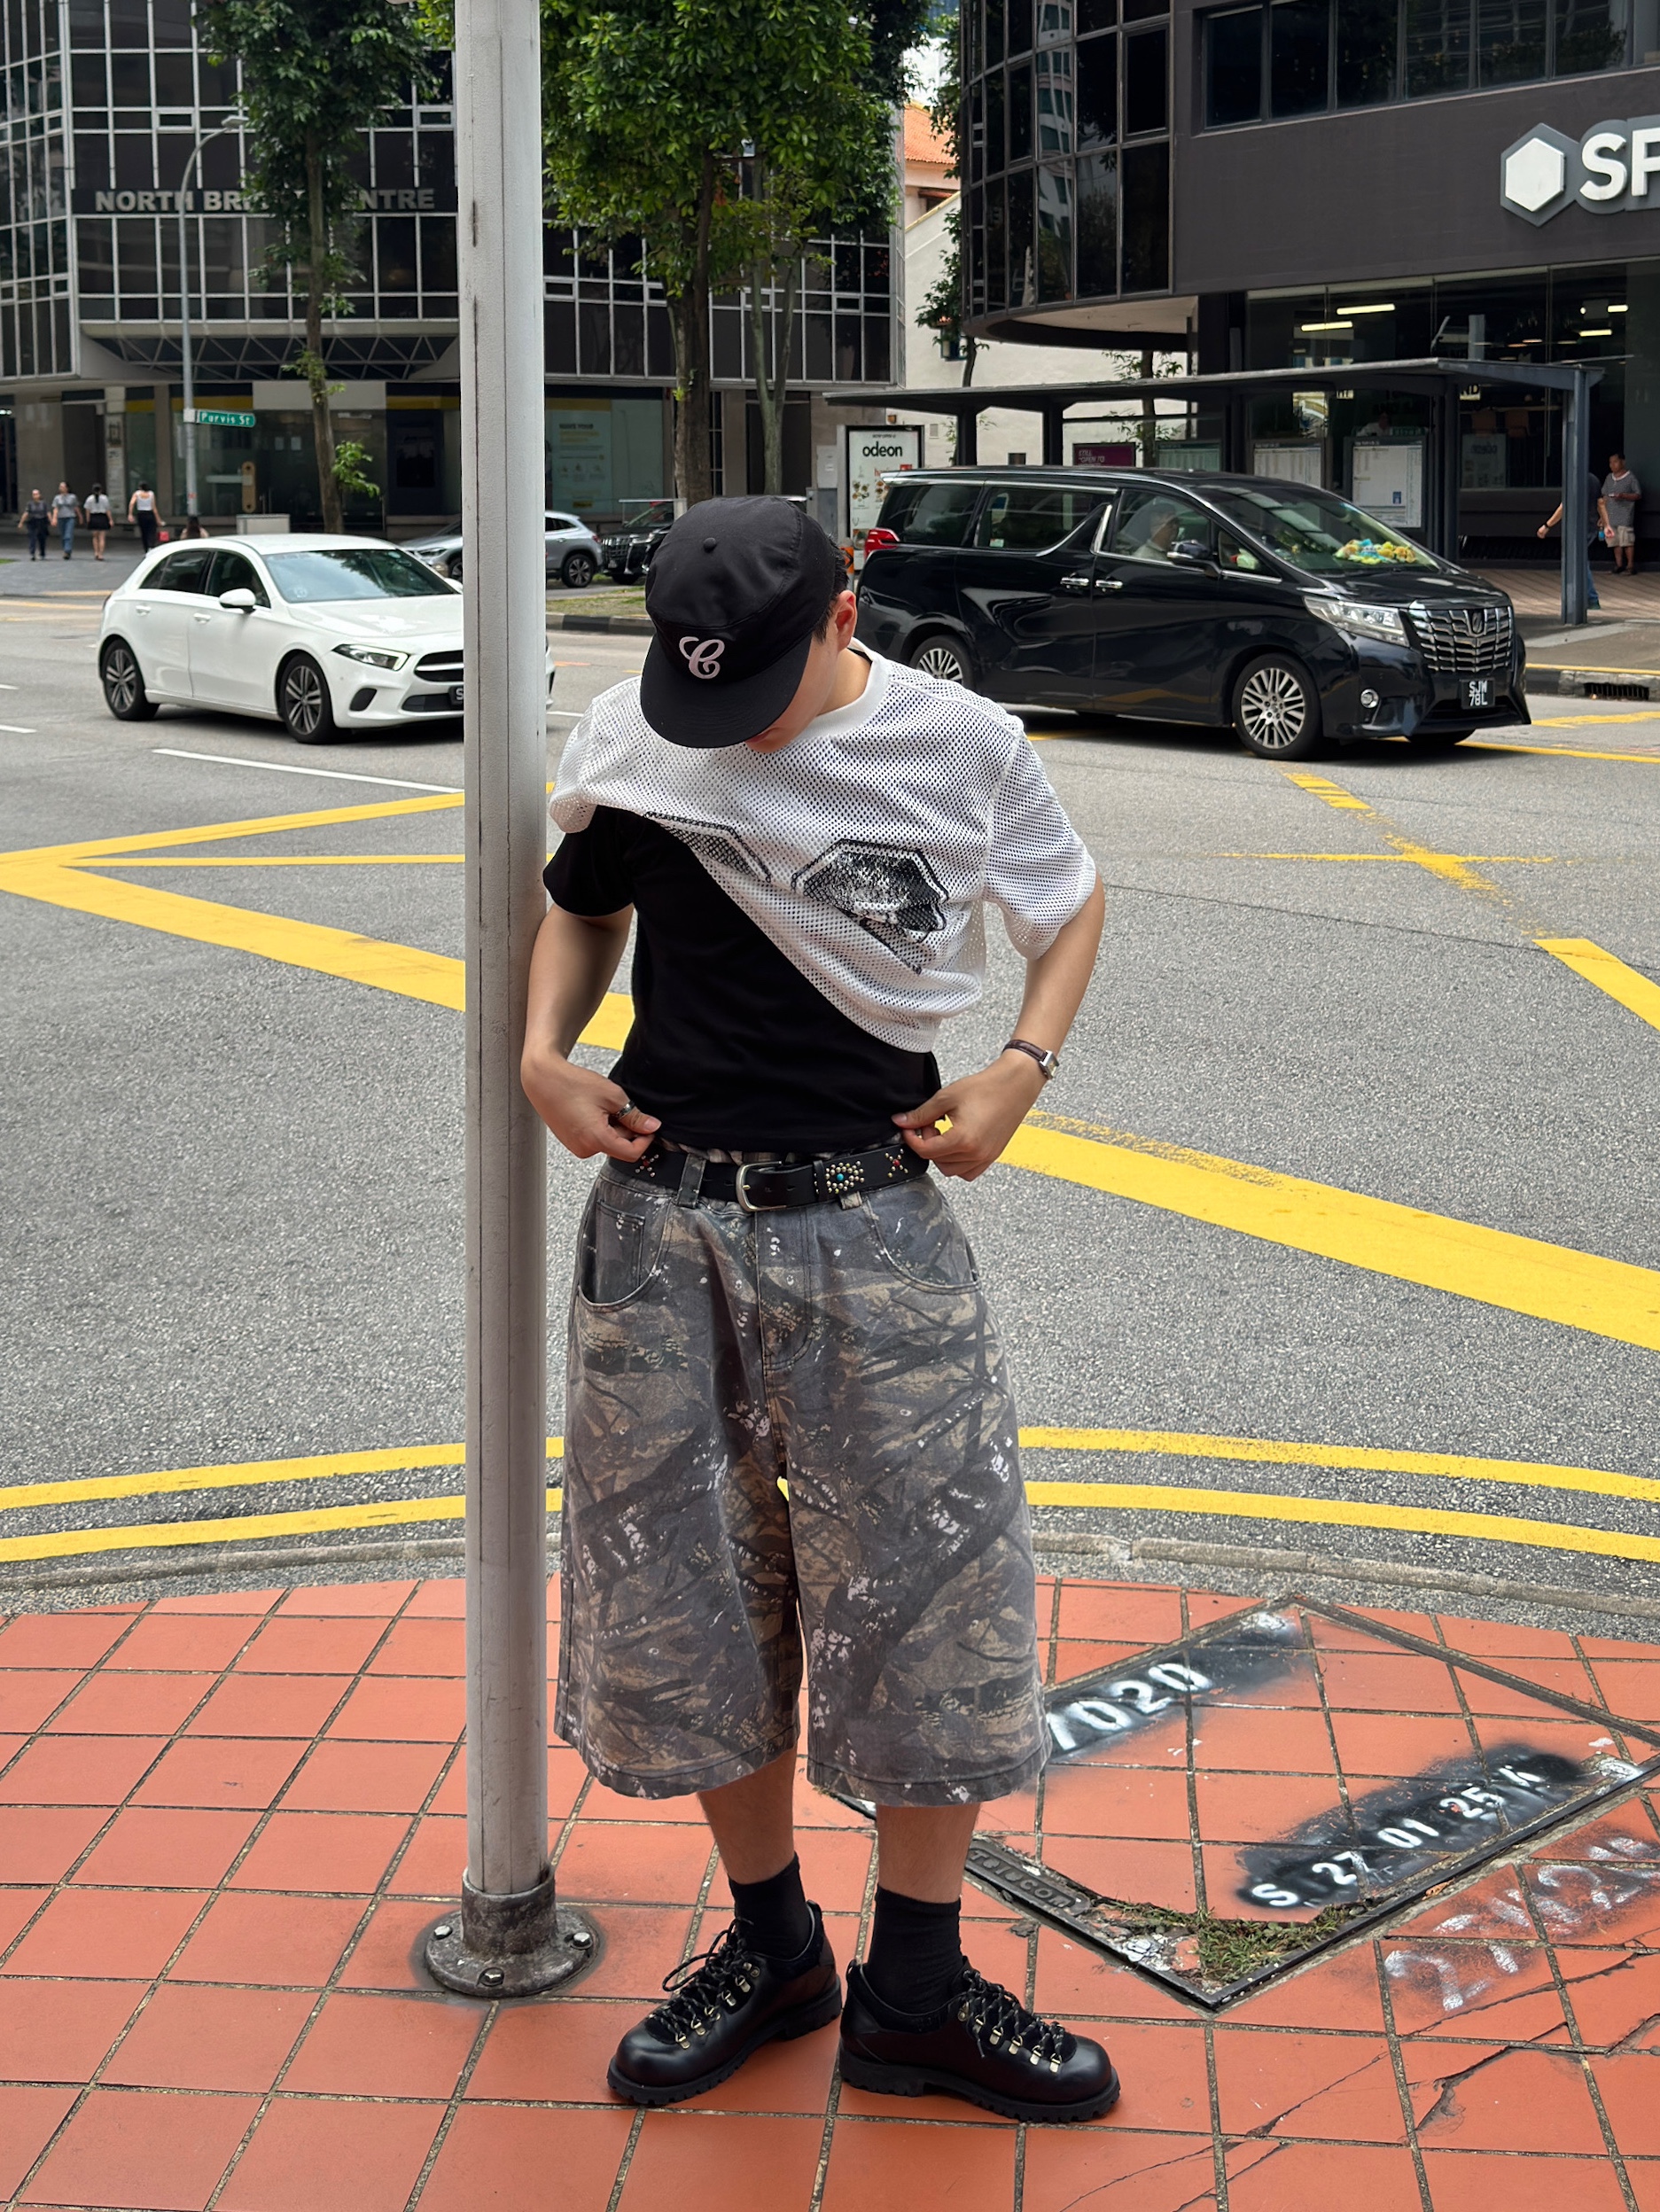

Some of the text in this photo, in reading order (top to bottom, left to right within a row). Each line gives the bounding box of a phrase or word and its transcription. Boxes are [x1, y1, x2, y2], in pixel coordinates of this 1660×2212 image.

[95, 191, 192, 212] NORTH
[238, 415, 251, 424] St
[862, 441, 903, 457] odeon
[1469, 693, 1488, 706] 78L
[1377, 1818, 1439, 1849] 01
